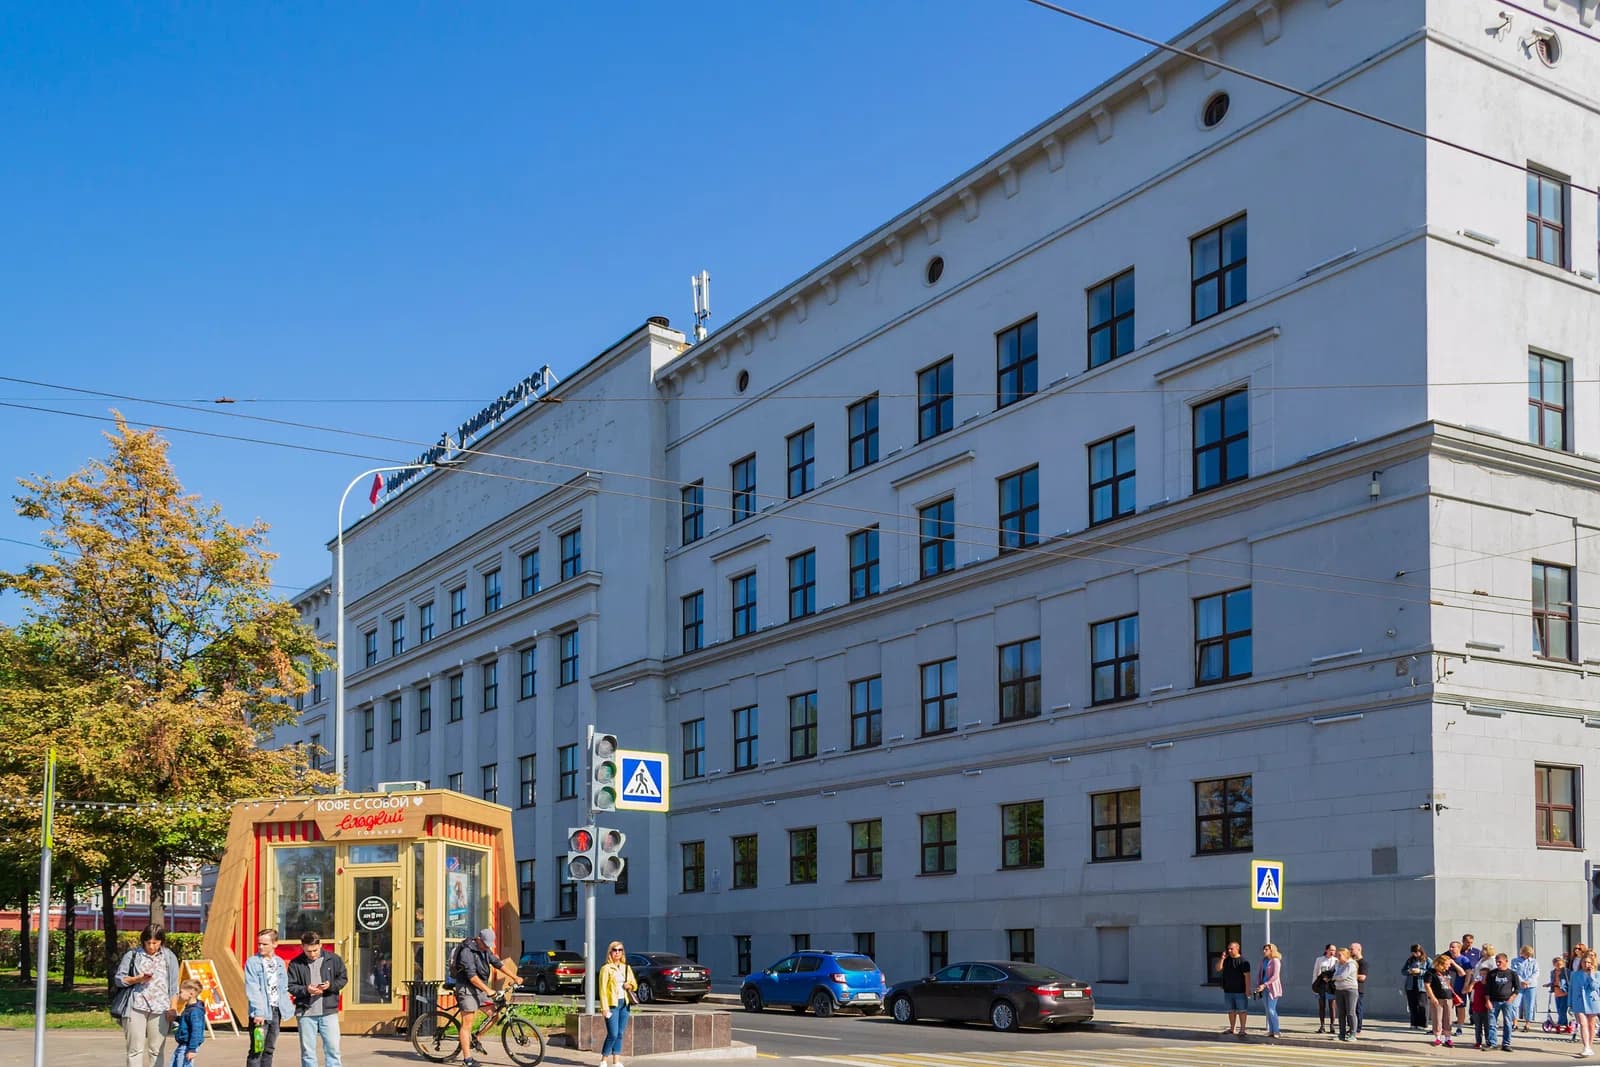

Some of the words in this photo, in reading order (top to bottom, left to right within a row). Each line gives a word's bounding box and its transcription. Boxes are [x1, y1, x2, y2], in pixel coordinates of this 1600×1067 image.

[317, 800, 351, 812] КОФЕ
[353, 799, 361, 810] С
[364, 796, 409, 809] СОБОЙ
